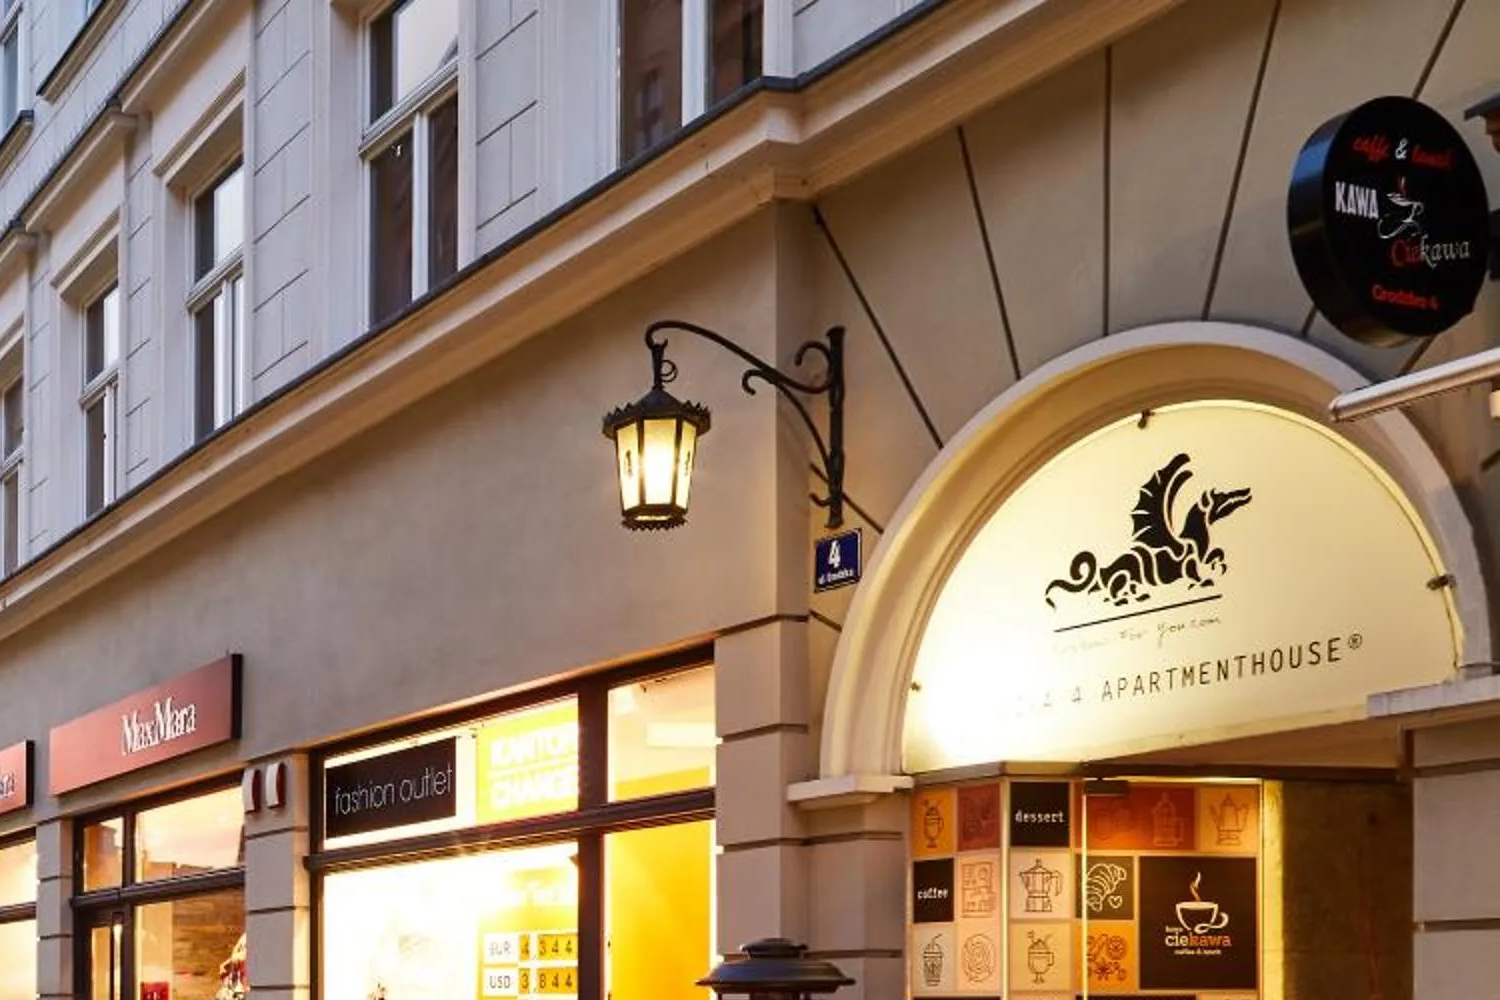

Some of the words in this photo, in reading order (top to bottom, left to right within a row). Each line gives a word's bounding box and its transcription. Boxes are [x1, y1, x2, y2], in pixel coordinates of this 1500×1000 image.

[1335, 181, 1379, 219] KAWA
[828, 540, 841, 568] 4
[121, 697, 197, 757] MaxMara
[335, 777, 395, 816] fashion
[400, 762, 452, 804] outlet
[1015, 810, 1065, 824] dessert
[917, 887, 949, 901] coffee
[1164, 931, 1232, 947] ciekawa
[489, 974, 512, 990] USD
